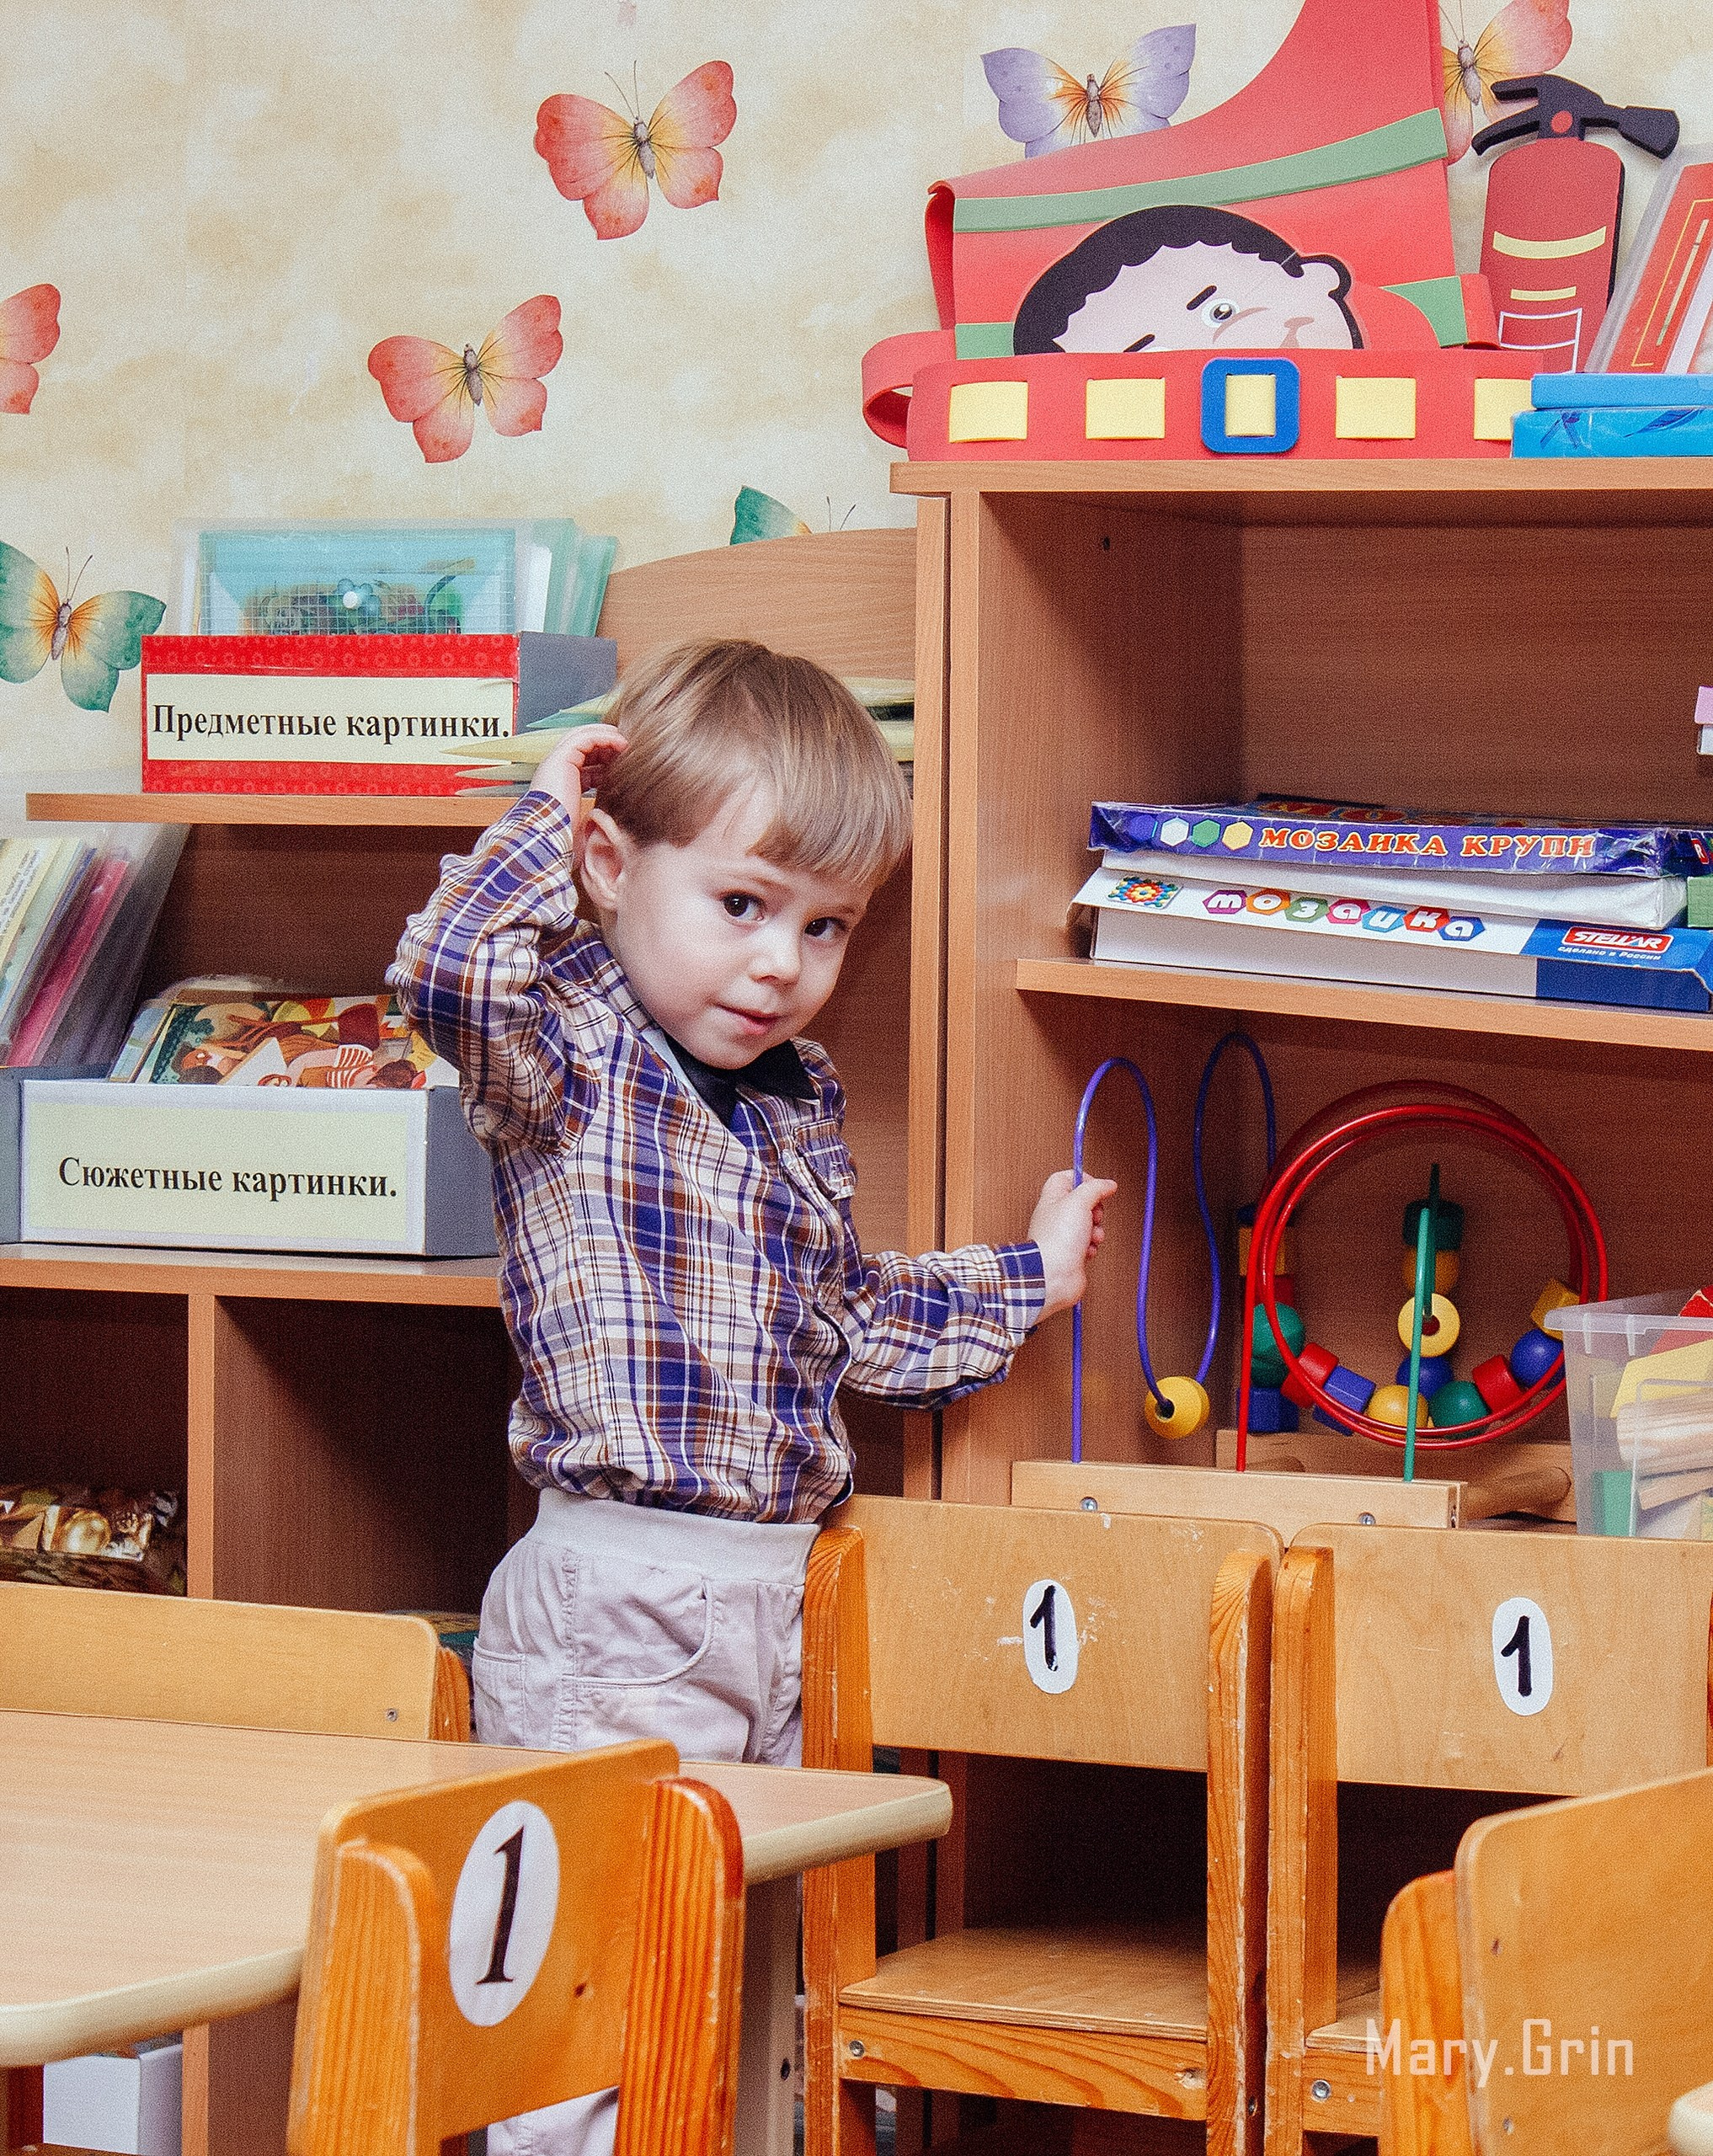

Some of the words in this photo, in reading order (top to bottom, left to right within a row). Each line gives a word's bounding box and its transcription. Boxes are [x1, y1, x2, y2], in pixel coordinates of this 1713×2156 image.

[152, 704, 337, 742] Предметные
[347, 714, 510, 745] картинки.
[1260, 827, 1448, 857] МОЗАИКА
[1619, 951, 1662, 961] России
[58, 1156, 222, 1192] Сюжетные
[232, 1171, 398, 1202] картинки.
[1029, 1584, 1059, 1672] 1
[1501, 1615, 1532, 1697] 1
[474, 1825, 525, 1985] 1
